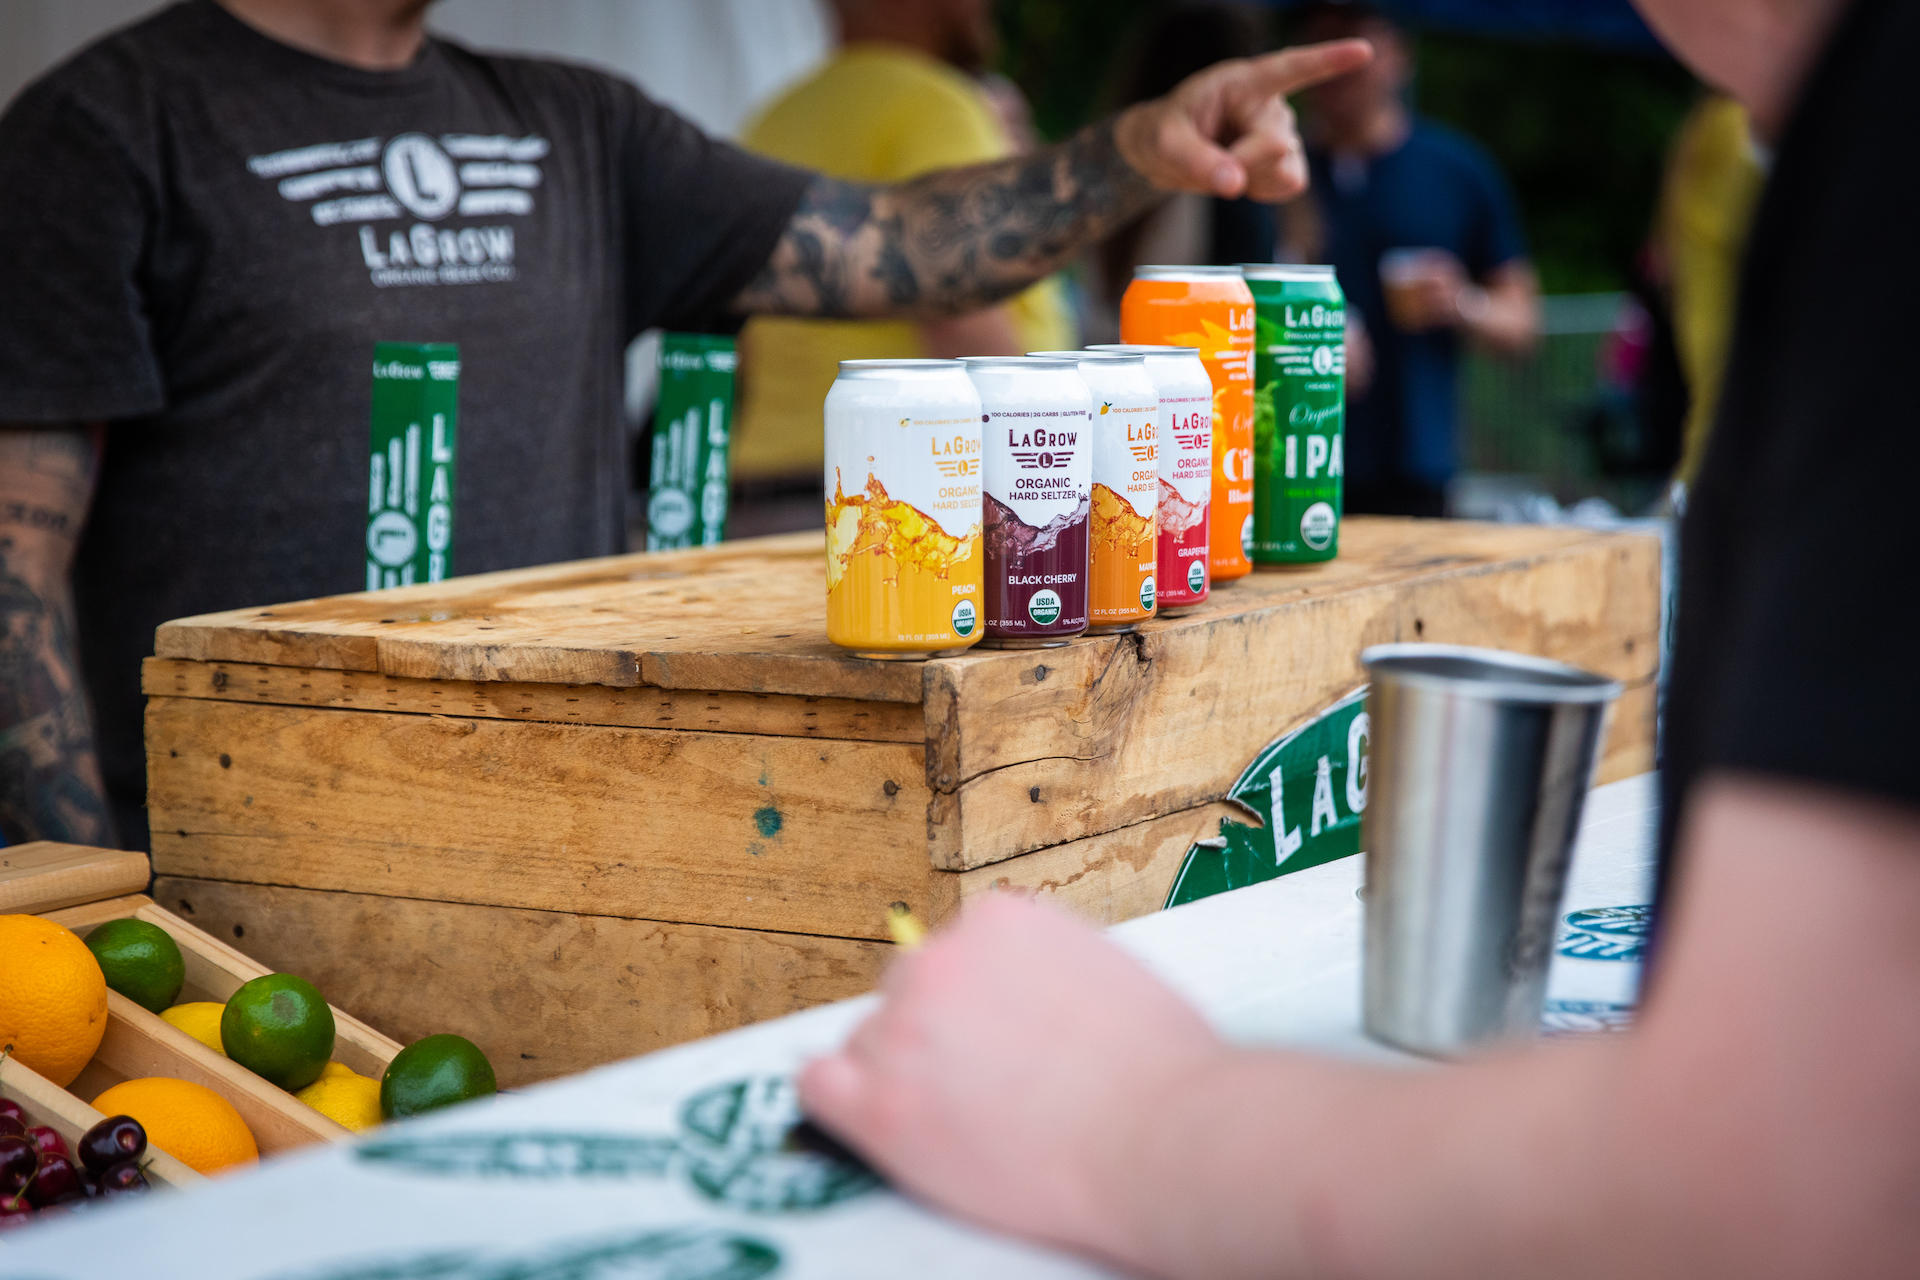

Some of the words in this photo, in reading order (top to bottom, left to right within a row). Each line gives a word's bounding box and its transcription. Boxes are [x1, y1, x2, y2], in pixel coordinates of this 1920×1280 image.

[1172, 413, 1212, 430] LAGRO
[1285, 434, 1343, 479] IPA
[1172, 471, 1194, 480] HARD
[1016, 477, 1071, 489] ORGANIC
[1127, 483, 1147, 493] HARD
[938, 485, 979, 499] ORGANIC
[1009, 492, 1039, 501] HARD
[1041, 490, 1076, 500] SELTZER
[932, 500, 959, 511] HARD
[1008, 575, 1042, 585] BLACK
[1043, 573, 1077, 584] CHERRY
[951, 584, 976, 595] PEACH
[1036, 597, 1055, 606] USDA
[957, 608, 972, 617] USDA
[1033, 608, 1058, 616] ORGANIC
[1000, 619, 1014, 628] (355
[1014, 620, 1026, 628] ML)
[1268, 710, 1370, 867] LAG
